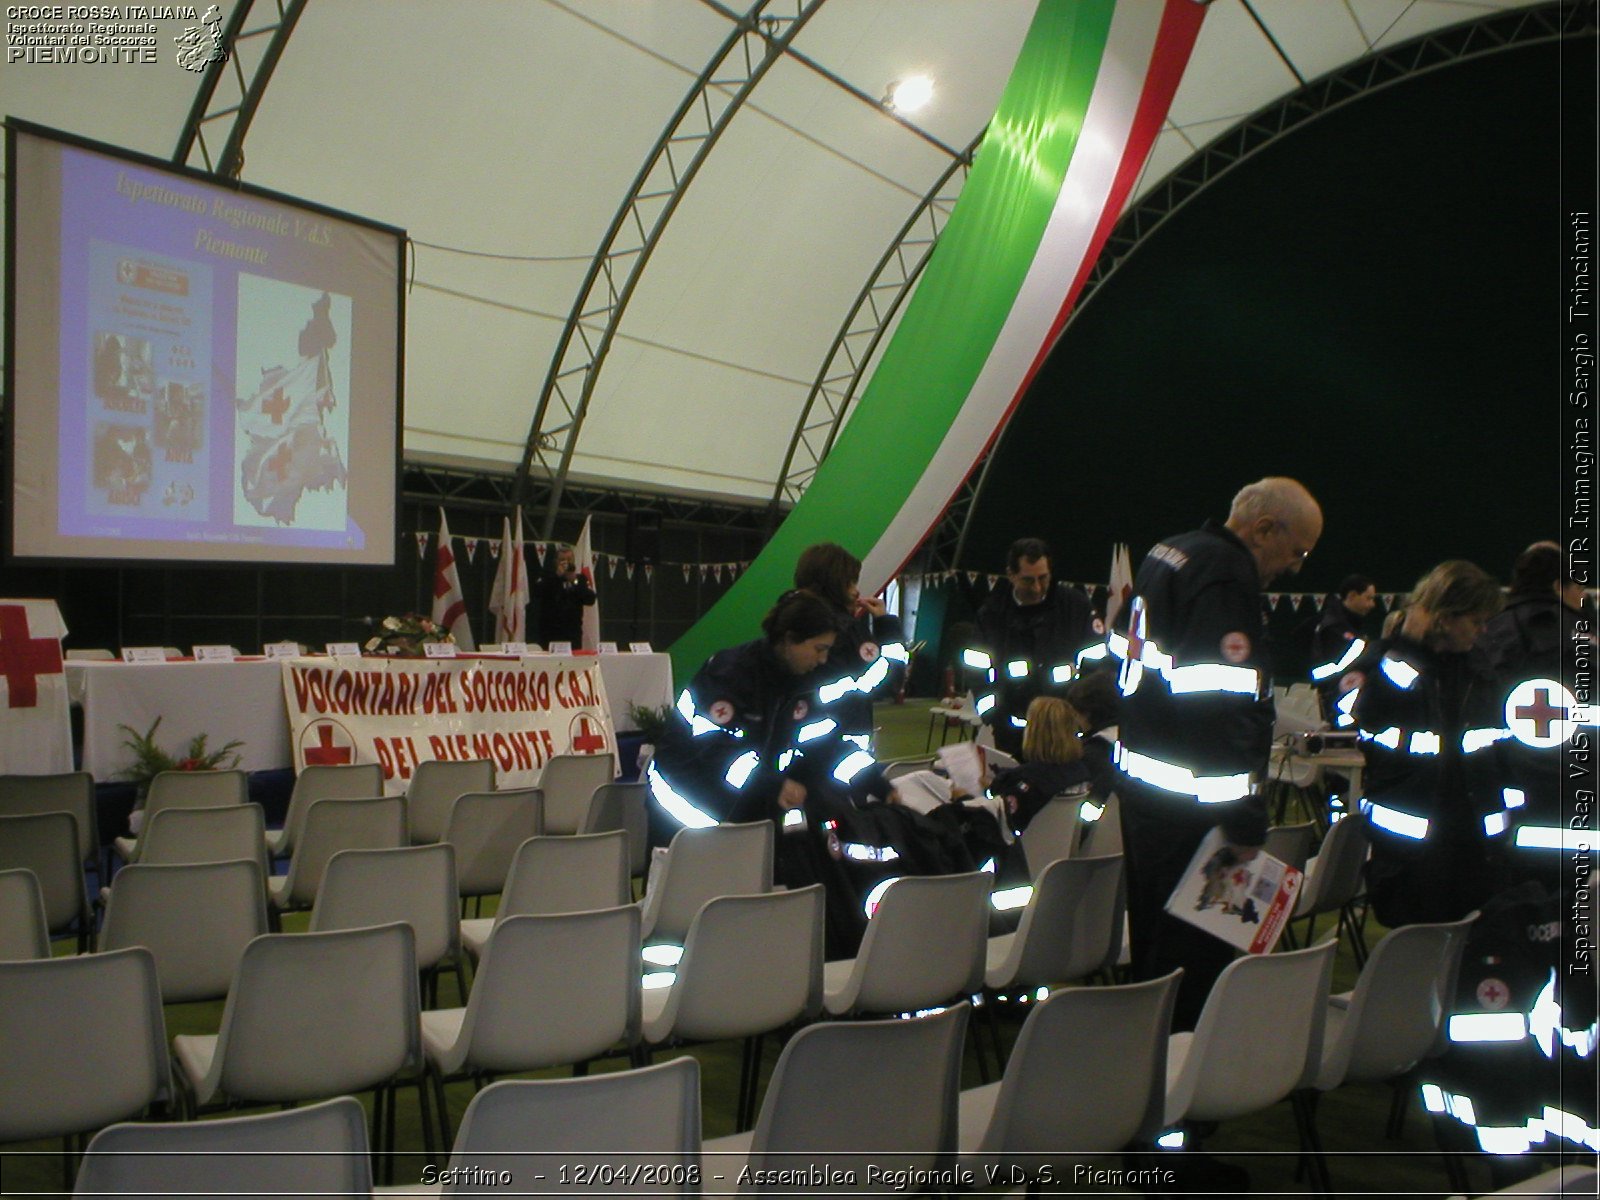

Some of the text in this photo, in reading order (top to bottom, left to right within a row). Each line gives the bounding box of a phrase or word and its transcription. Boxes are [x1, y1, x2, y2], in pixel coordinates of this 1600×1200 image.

[115, 171, 208, 216] Ispettorato
[212, 199, 289, 236] Regionale
[195, 228, 270, 265] Piemonte
[291, 666, 600, 716] VOLONTARI DEL SOCCORSO C.R.I.
[428, 730, 554, 773] PIEMONTE
